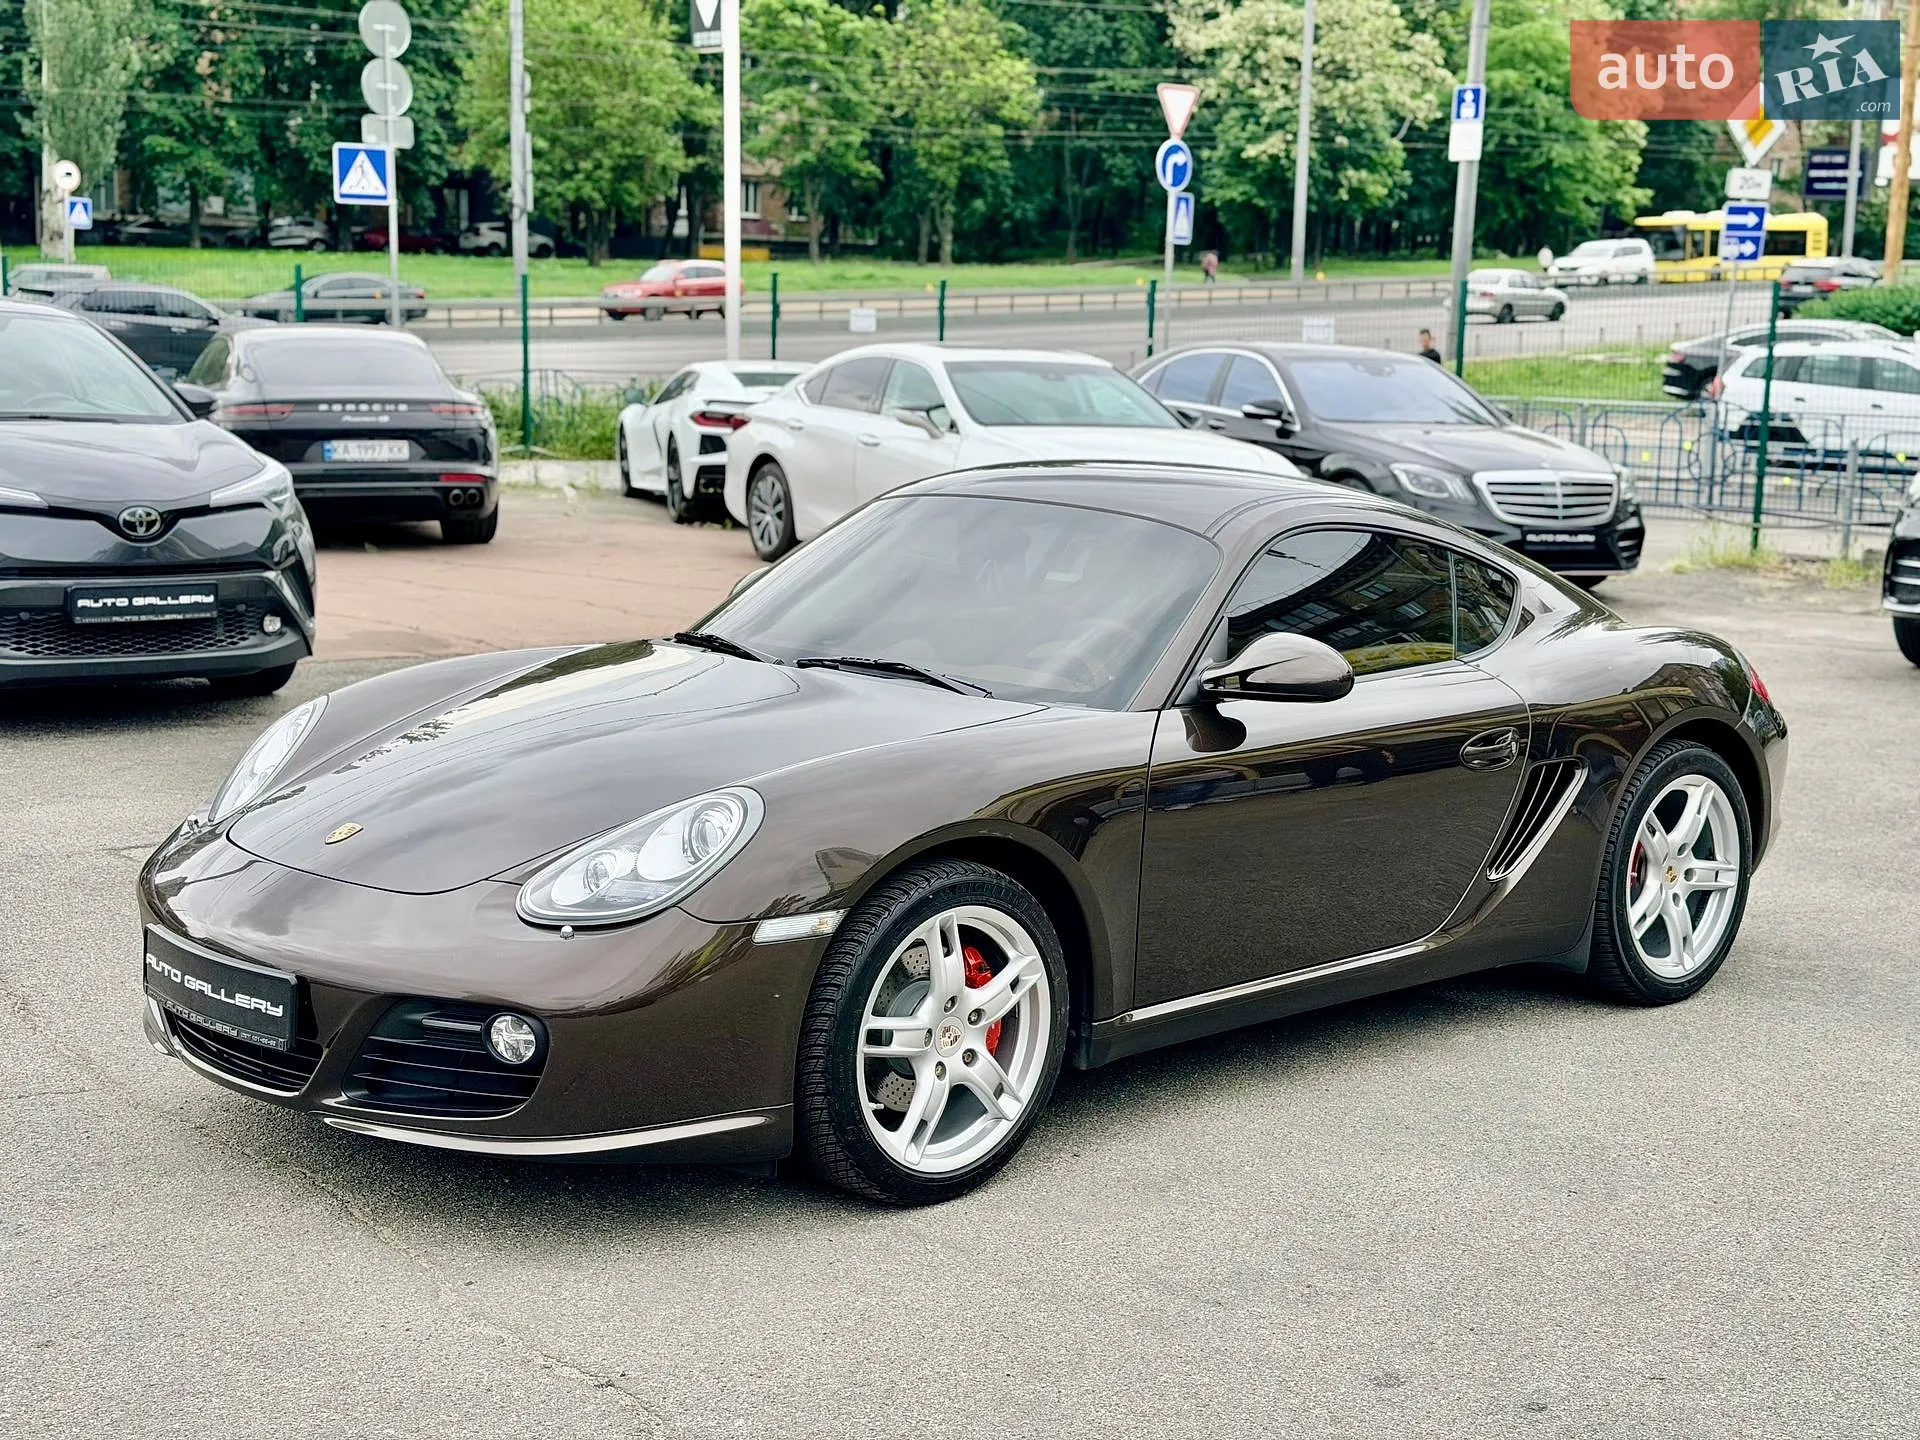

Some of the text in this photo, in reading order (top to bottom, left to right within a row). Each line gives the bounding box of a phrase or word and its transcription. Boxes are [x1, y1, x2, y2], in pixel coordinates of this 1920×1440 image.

[77, 594, 215, 608] AUTO GALLERY
[146, 952, 284, 1017] AUTO GALLERY
[165, 1000, 238, 1037] AUTO GALLERY
